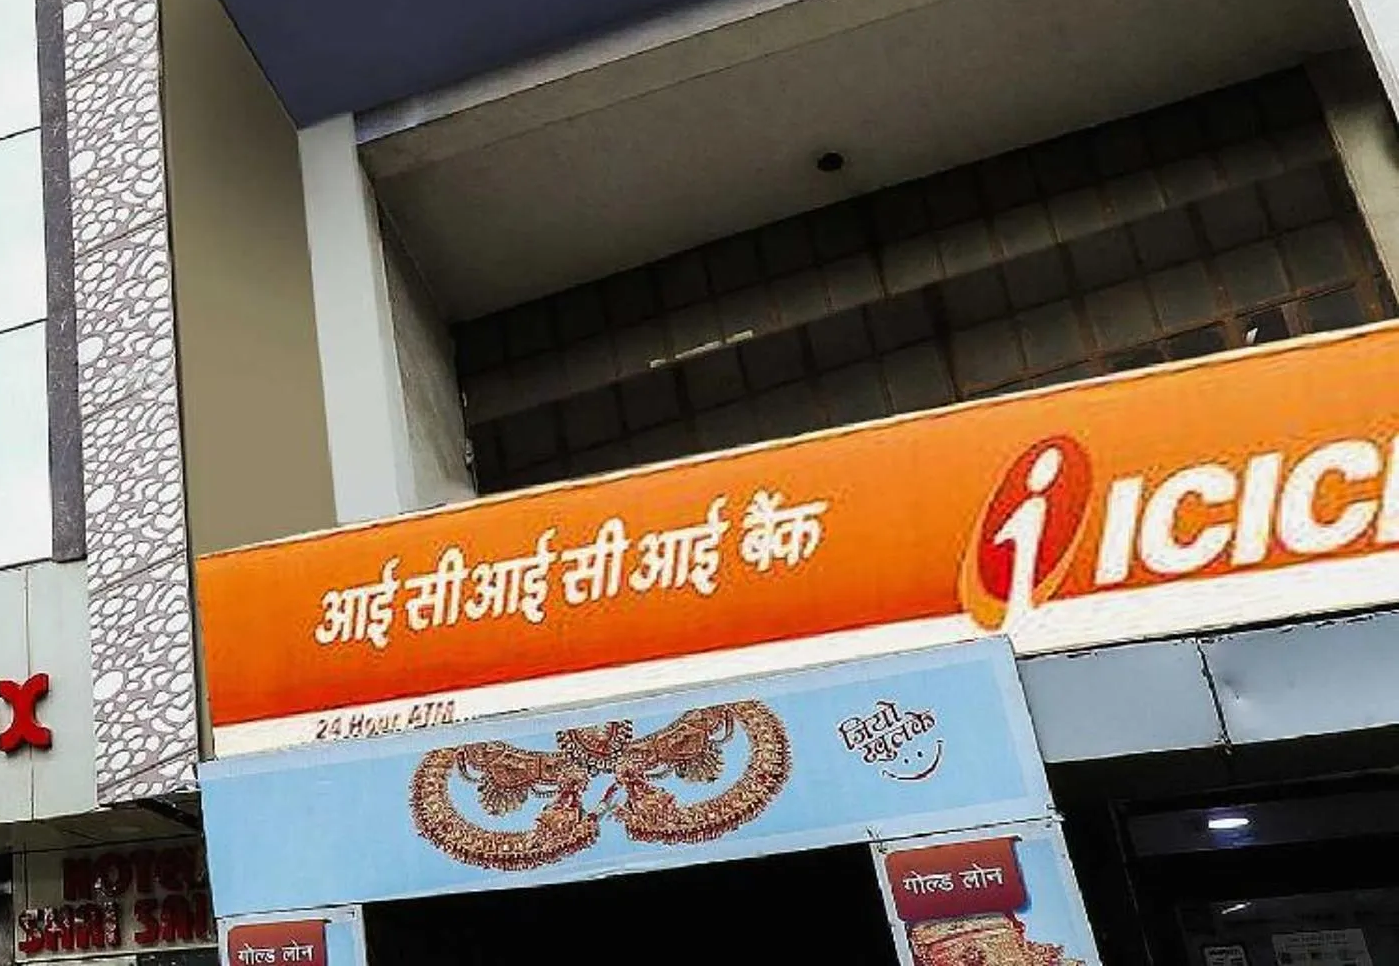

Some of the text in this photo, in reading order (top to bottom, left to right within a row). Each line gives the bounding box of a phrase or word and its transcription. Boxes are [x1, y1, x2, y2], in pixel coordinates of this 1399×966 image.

[315, 488, 828, 649] आई सी आई सी आई बैंक
[902, 862, 1004, 896] गोल्ड लोन
[237, 939, 314, 966] गोल्ड लोन
